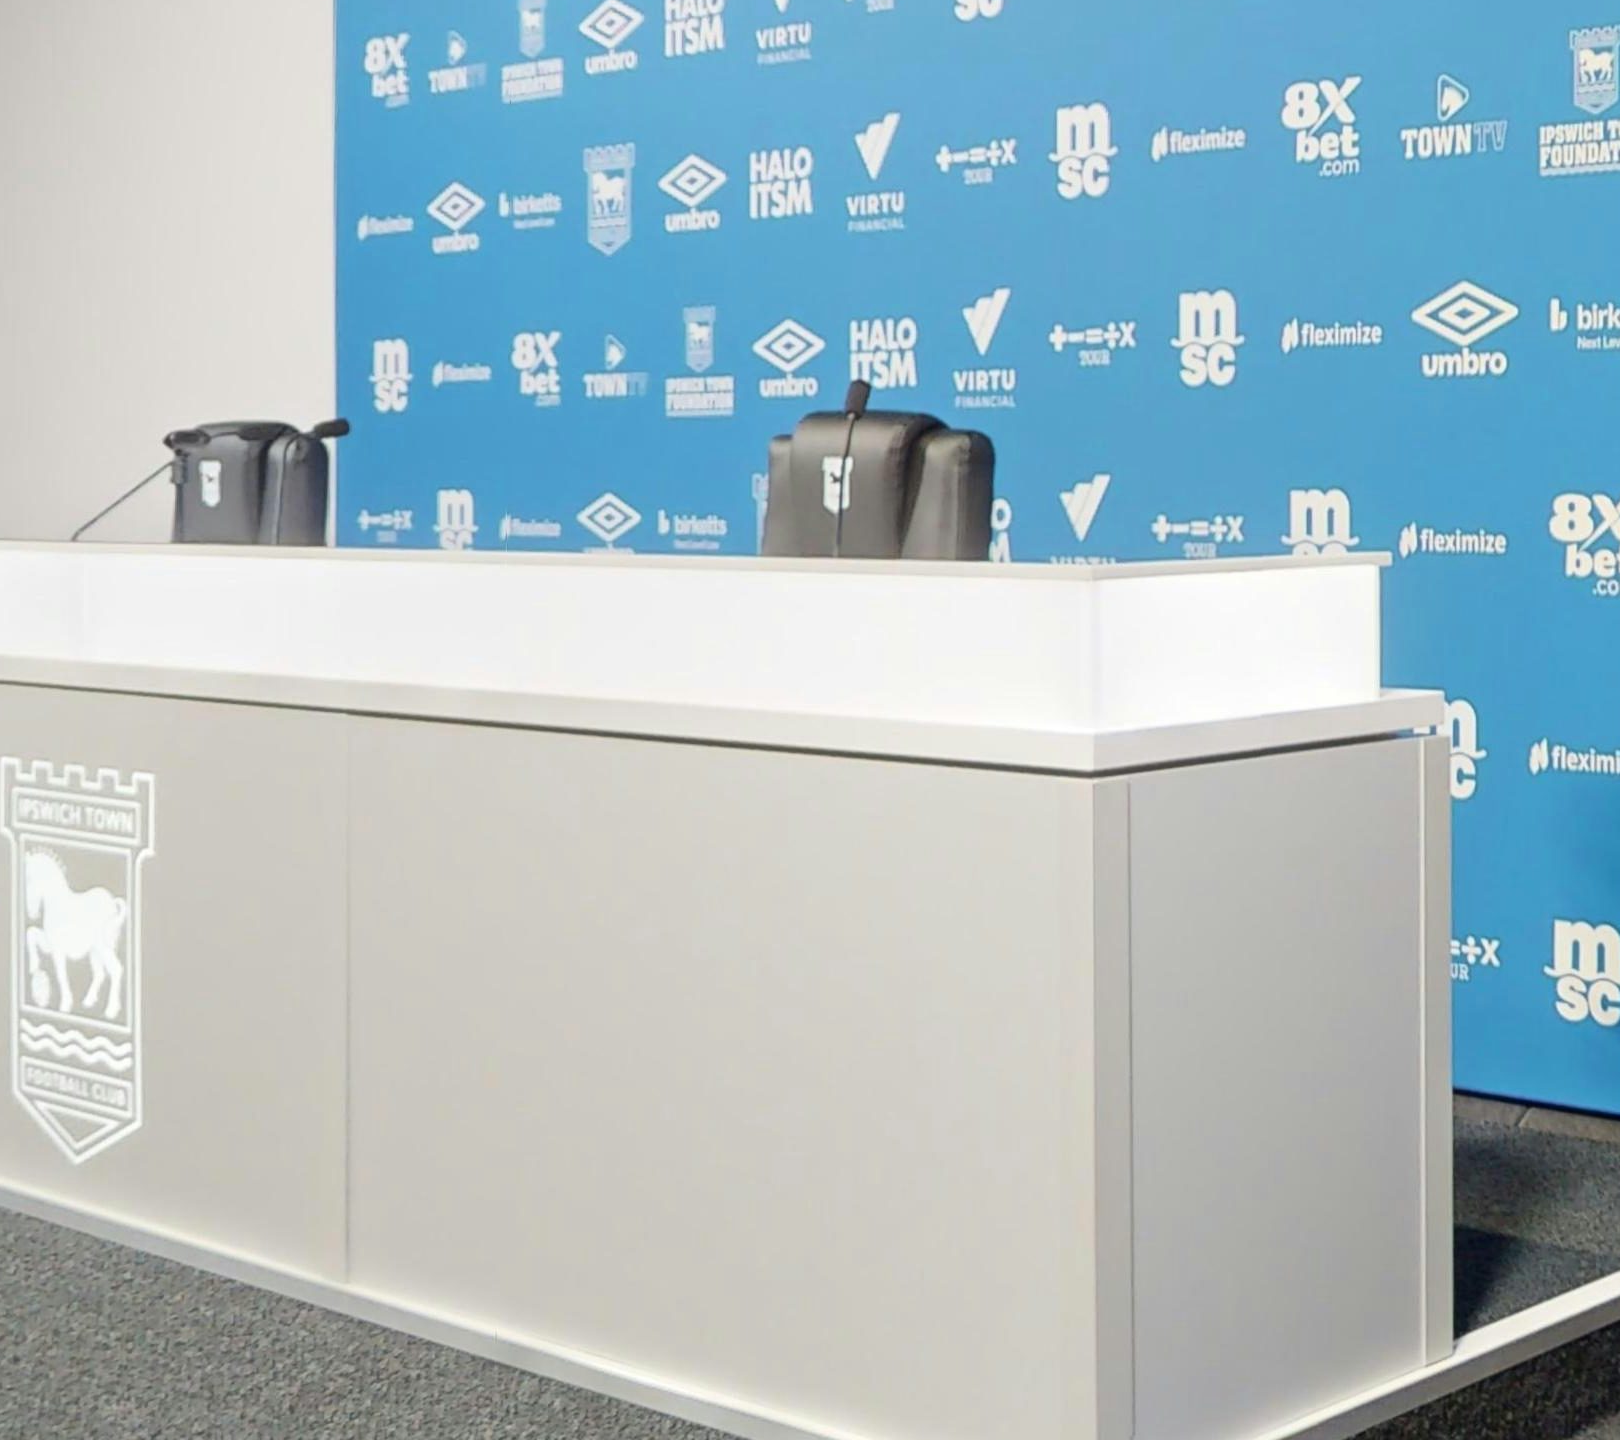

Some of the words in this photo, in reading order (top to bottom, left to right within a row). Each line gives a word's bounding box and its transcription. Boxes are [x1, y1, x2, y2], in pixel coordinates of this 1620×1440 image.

[665, 15, 725, 57] ITSM
[756, 23, 811, 49] VIRTU
[1169, 127, 1246, 153] fleximize
[1296, 126, 1359, 161] bet
[1539, 121, 1605, 150] IPSWICH
[750, 147, 813, 187] HALO
[1319, 158, 1360, 176] .com
[750, 179, 813, 219] ITSM
[846, 192, 904, 216] VIRTU
[850, 318, 917, 356] HALO
[1301, 322, 1382, 346] fleximize
[850, 351, 917, 389] ITSM
[1422, 345, 1507, 376] umbro
[760, 372, 818, 397] umbro
[954, 369, 1016, 392] VIRTU
[1420, 528, 1506, 553] fleximize
[18, 800, 80, 828] IPSWICH
[84, 805, 134, 834] TOWN
